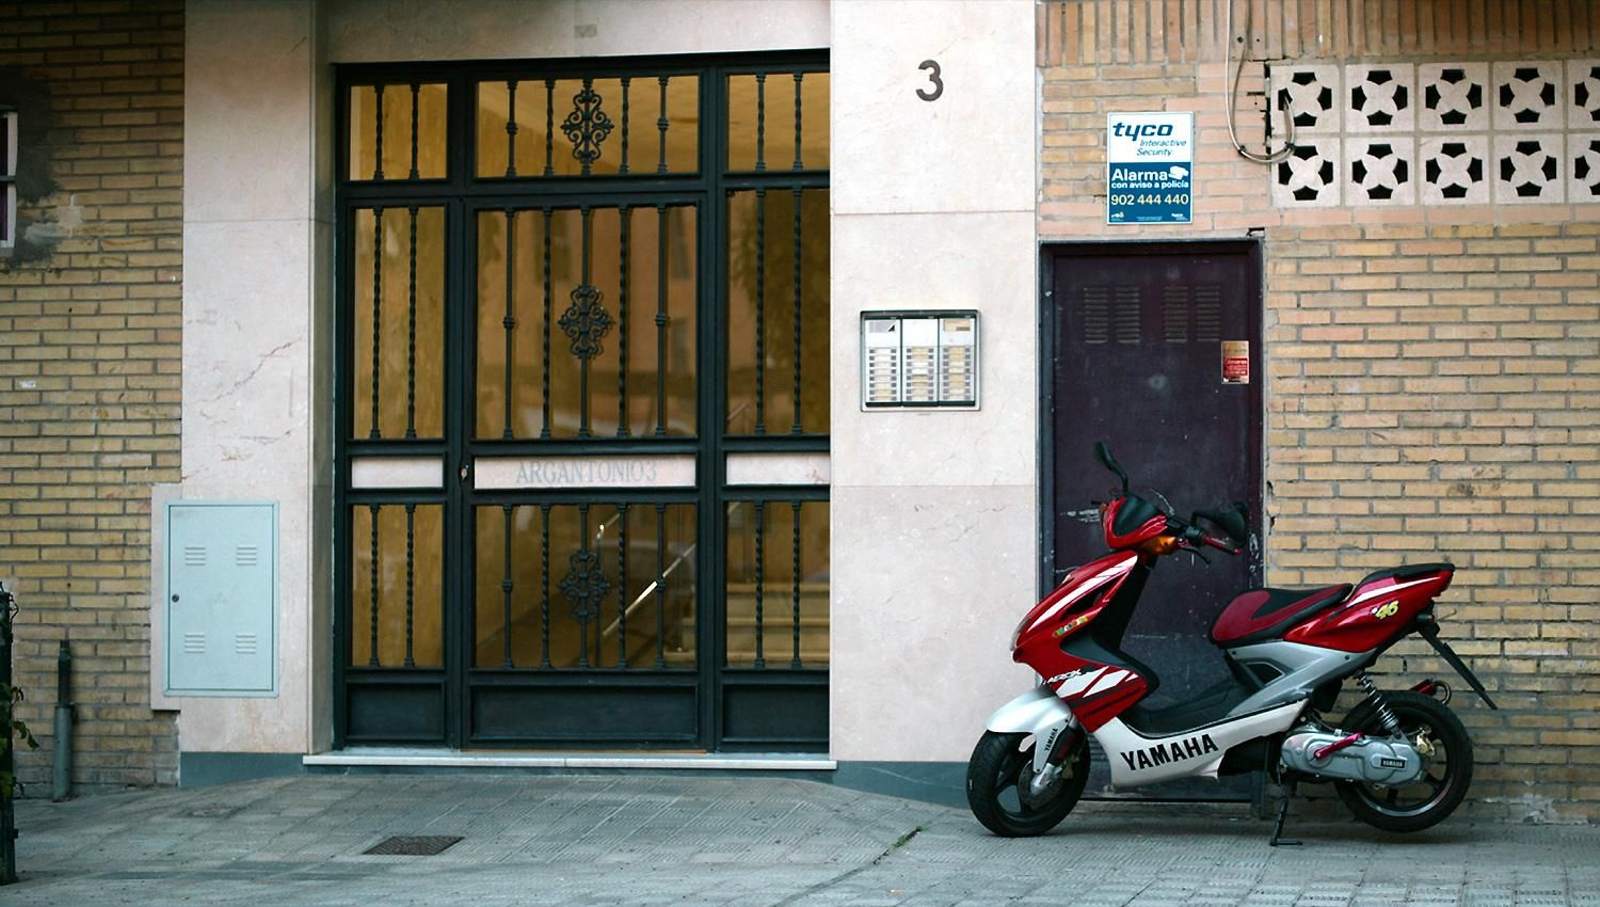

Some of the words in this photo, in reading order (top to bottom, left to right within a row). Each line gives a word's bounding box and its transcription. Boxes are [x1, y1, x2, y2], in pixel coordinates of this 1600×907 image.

[915, 59, 944, 102] 3
[1112, 122, 1174, 142] tyco
[1139, 139, 1187, 147] Interactive
[1136, 147, 1172, 157] Security
[1111, 168, 1168, 181] Alarma
[1111, 181, 1128, 189] con
[1129, 180, 1153, 189] aviso
[1153, 181, 1160, 189] a
[1111, 194, 1135, 206] 902
[1136, 194, 1161, 205] 444
[1164, 193, 1189, 205] 440
[1374, 600, 1399, 620] 46
[1044, 727, 1058, 751] YAMAHA
[1120, 733, 1219, 771] YAMAHA
